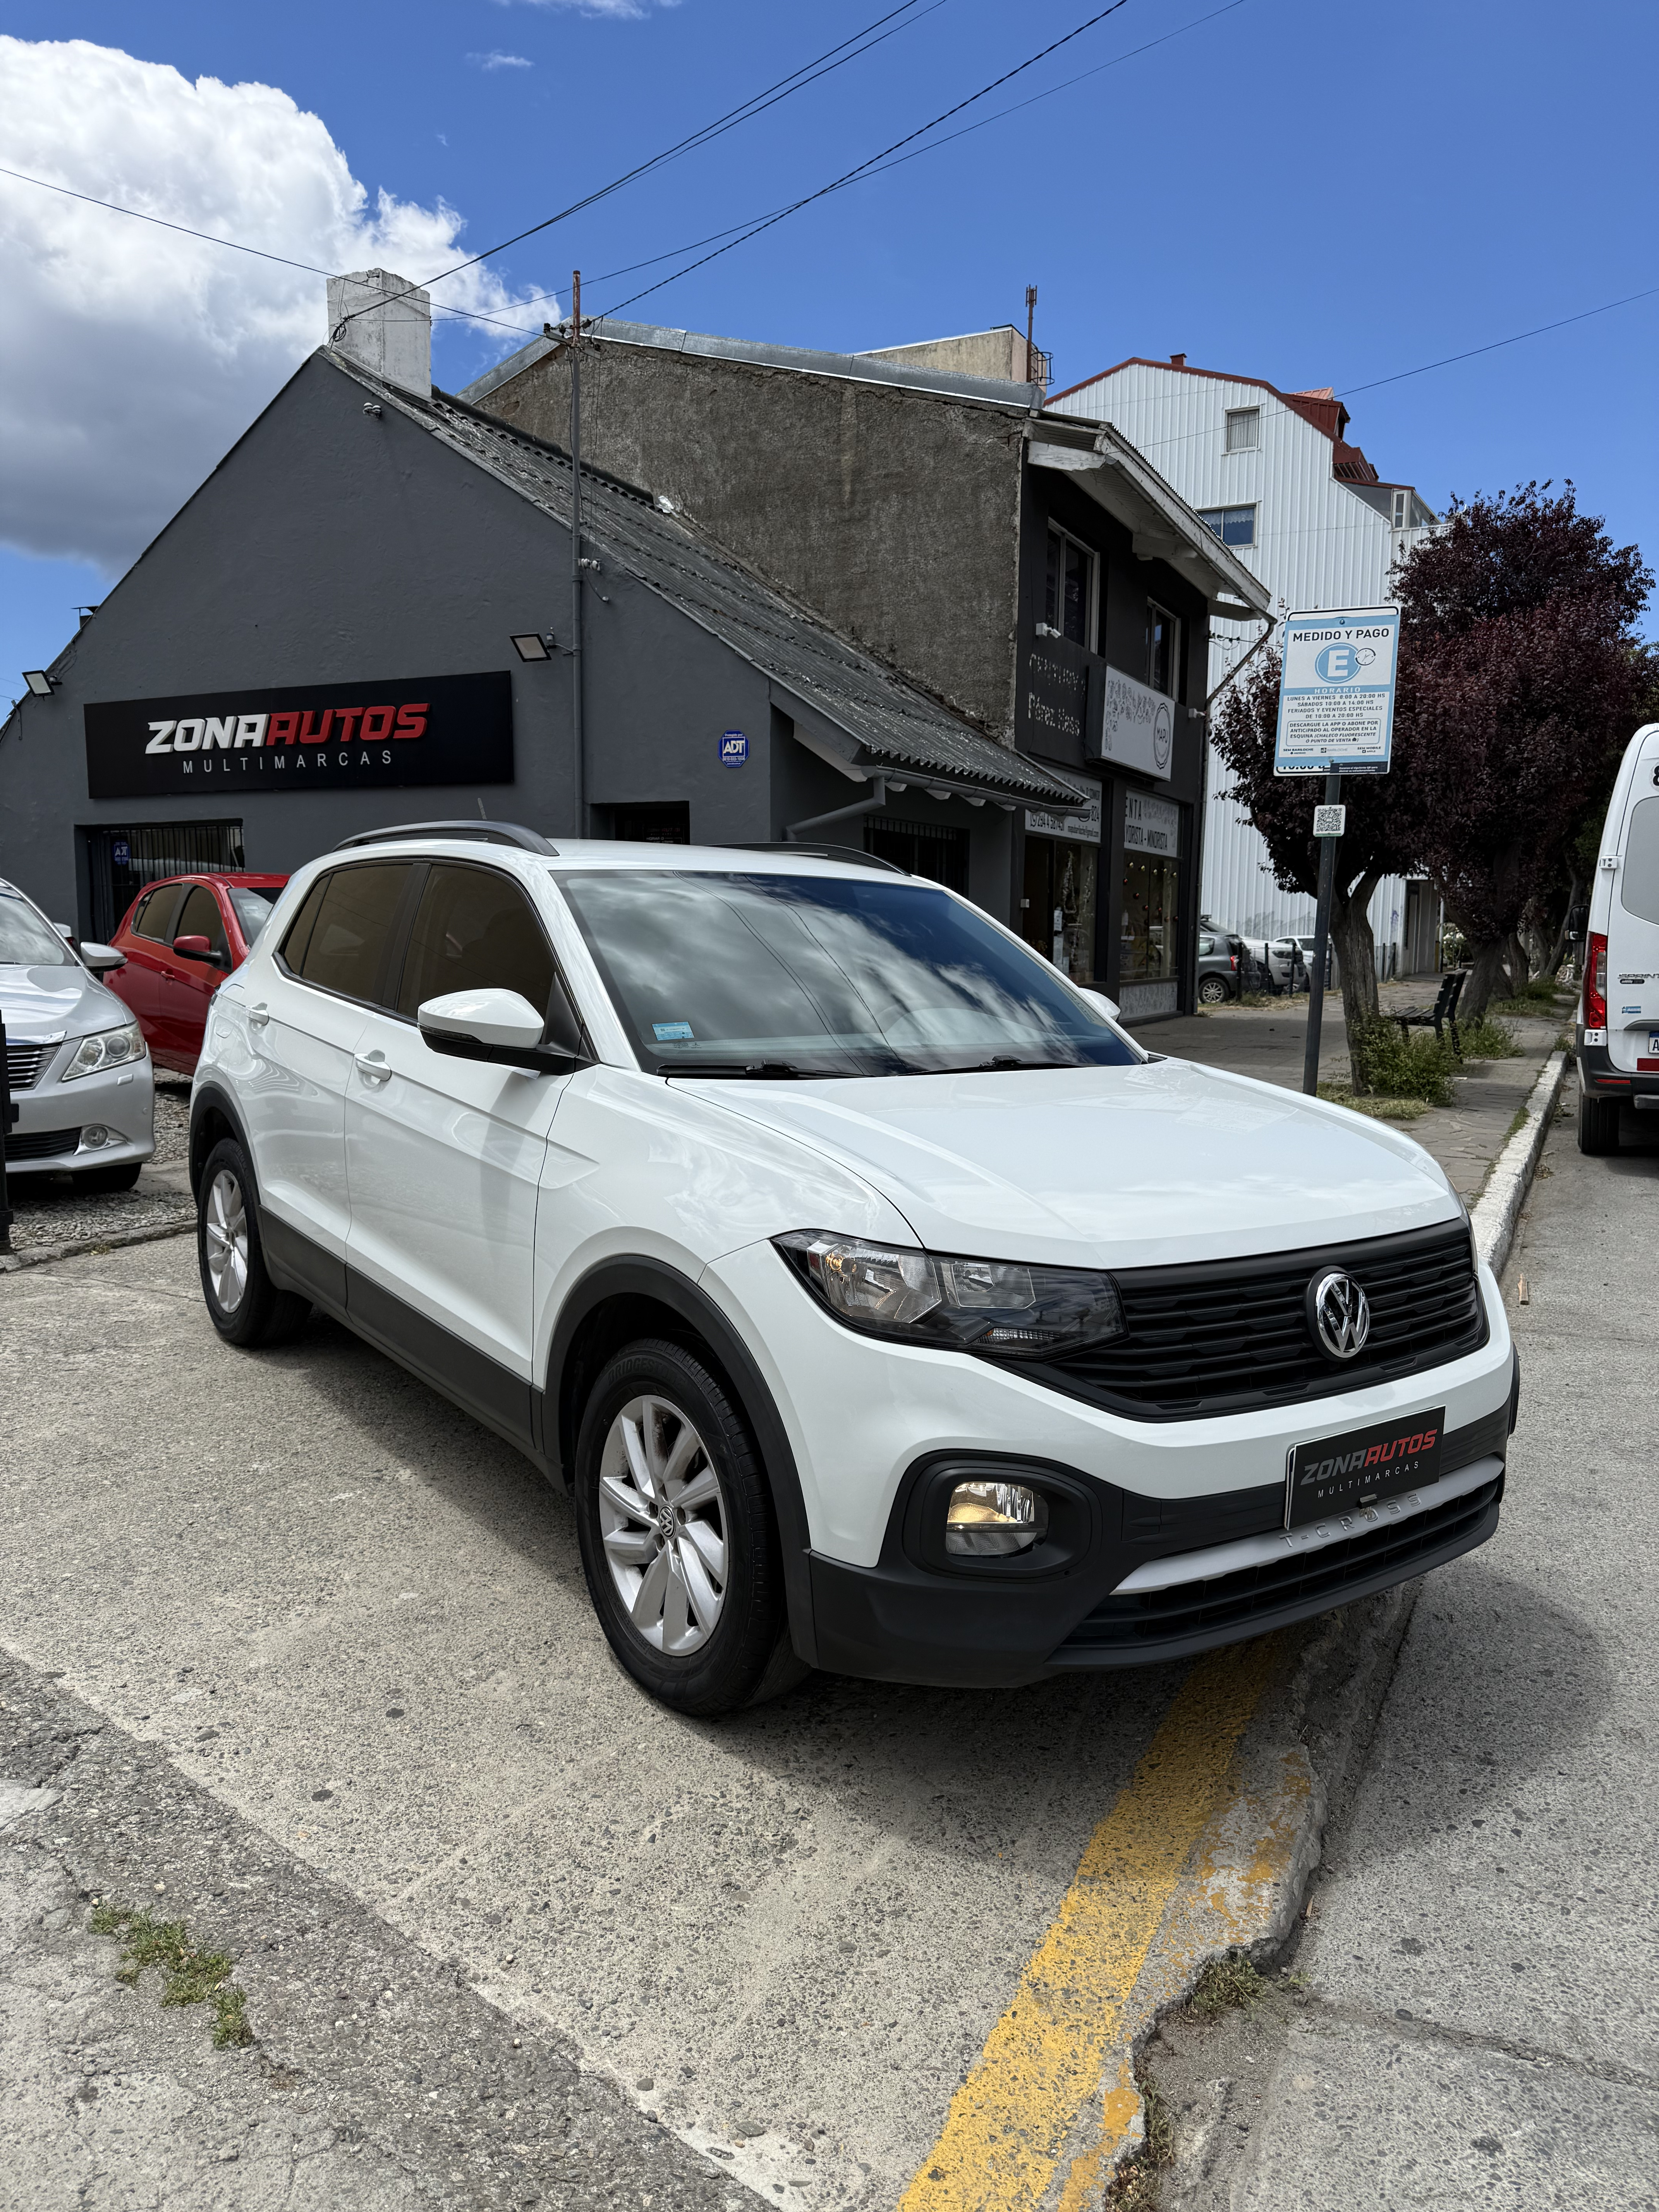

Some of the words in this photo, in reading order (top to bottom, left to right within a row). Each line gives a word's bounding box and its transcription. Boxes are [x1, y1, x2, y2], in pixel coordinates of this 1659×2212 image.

[1293, 631, 1341, 642] MEDIDO
[1345, 630, 1353, 639] Y
[1356, 628, 1389, 639] PAGO
[1327, 649, 1350, 677] E
[145, 702, 431, 754] ZONAAUTOS
[723, 740, 745, 754] ADT
[183, 750, 391, 774] MULTIMARCAS
[1125, 796, 1142, 821] ENTA
[1125, 824, 1144, 845] YORISTA
[1300, 1429, 1437, 1485] ZONAAUTOS
[1318, 1462, 1418, 1498] MULTIMARCAS
[1278, 1493, 1422, 1547] T-CROSS
